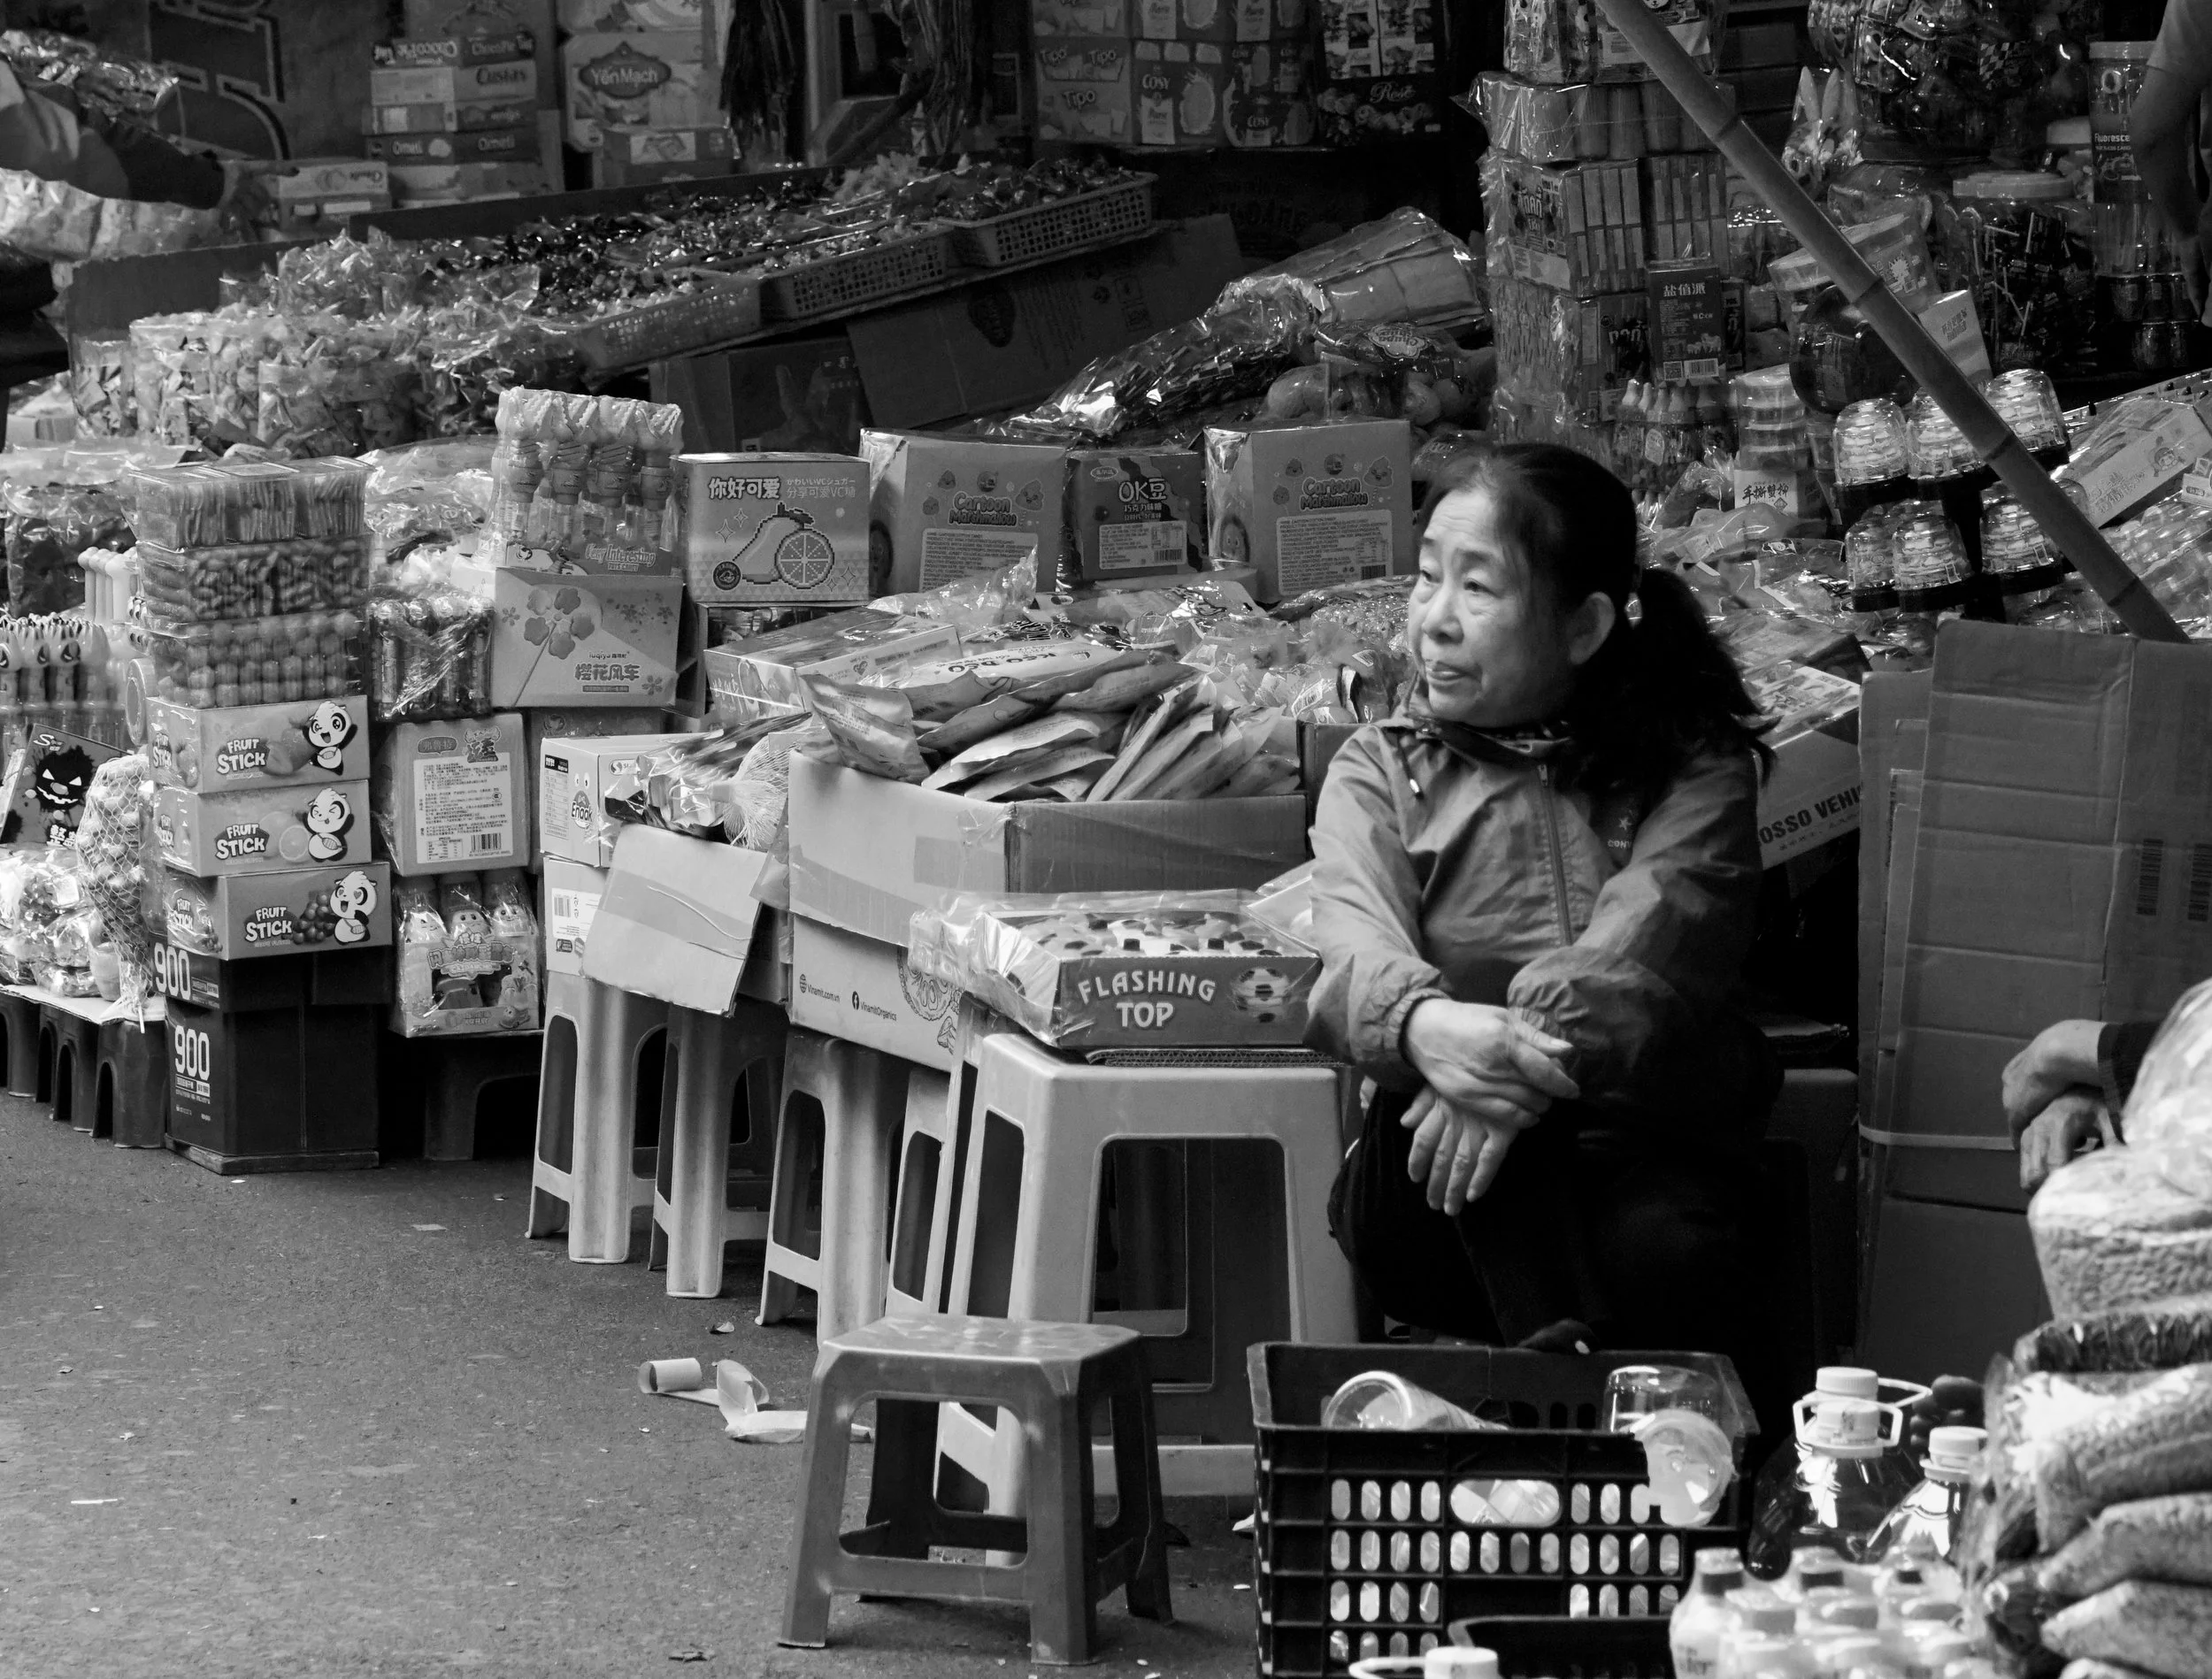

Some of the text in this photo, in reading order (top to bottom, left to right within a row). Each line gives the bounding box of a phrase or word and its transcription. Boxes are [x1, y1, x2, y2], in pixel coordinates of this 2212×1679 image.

[1087, 49, 1118, 66] Tipo
[1062, 90, 1097, 111] Tipo
[709, 476, 781, 499] 你好可爱
[1118, 478, 1167, 502] OK豆
[1302, 476, 1363, 496] Cartoon
[953, 491, 1011, 513] Cartoon
[1300, 493, 1369, 511] Marshmallow
[949, 509, 1018, 526] Marshmallow
[607, 543, 657, 568] Interesting
[575, 663, 641, 681] 樱花风车
[227, 738, 261, 754] FRUIT
[216, 752, 267, 775] STICK
[572, 801, 593, 822] Enaak
[226, 824, 260, 840] FRUIT
[215, 837, 267, 861] STICK
[255, 906, 288, 922] FRUIT
[244, 920, 293, 943] STICK
[154, 942, 191, 1000] 900
[807, 984, 841, 1002] Vinamit.com.vn
[1077, 970, 1217, 1006] FLASHING
[860, 1001, 897, 1022] VinamitOrganics
[1116, 1001, 1174, 1028] TOP
[174, 1025, 210, 1081] 900
